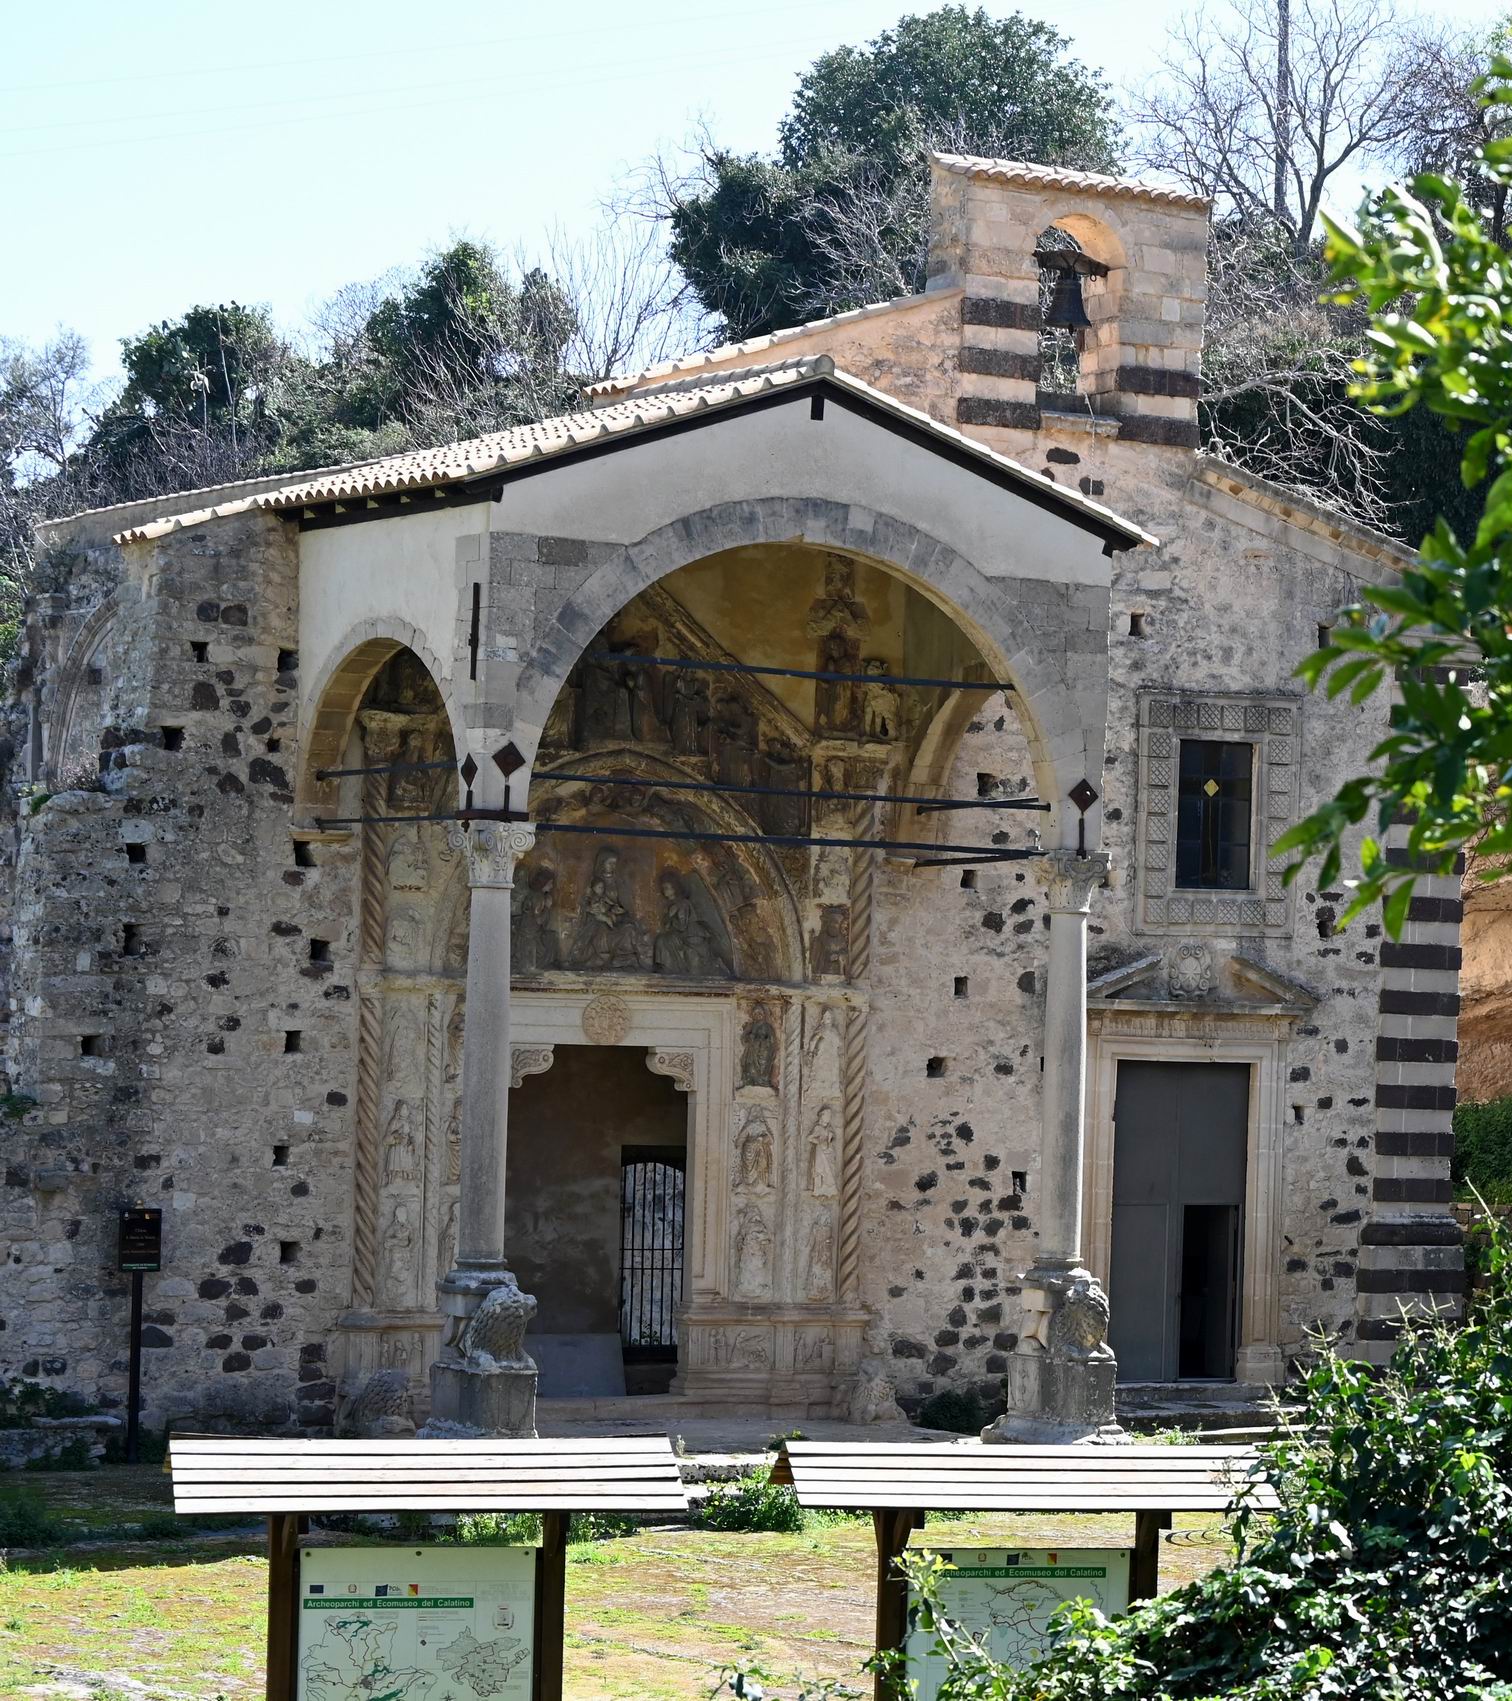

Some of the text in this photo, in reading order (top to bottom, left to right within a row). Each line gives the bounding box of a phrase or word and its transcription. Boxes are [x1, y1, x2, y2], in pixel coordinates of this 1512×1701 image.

[941, 1569, 1103, 1578] rcheoparchi ed Ecomuseo del Calatino
[307, 1600, 470, 1609] Archeoparchi ed Ecomuseo del Calatino
